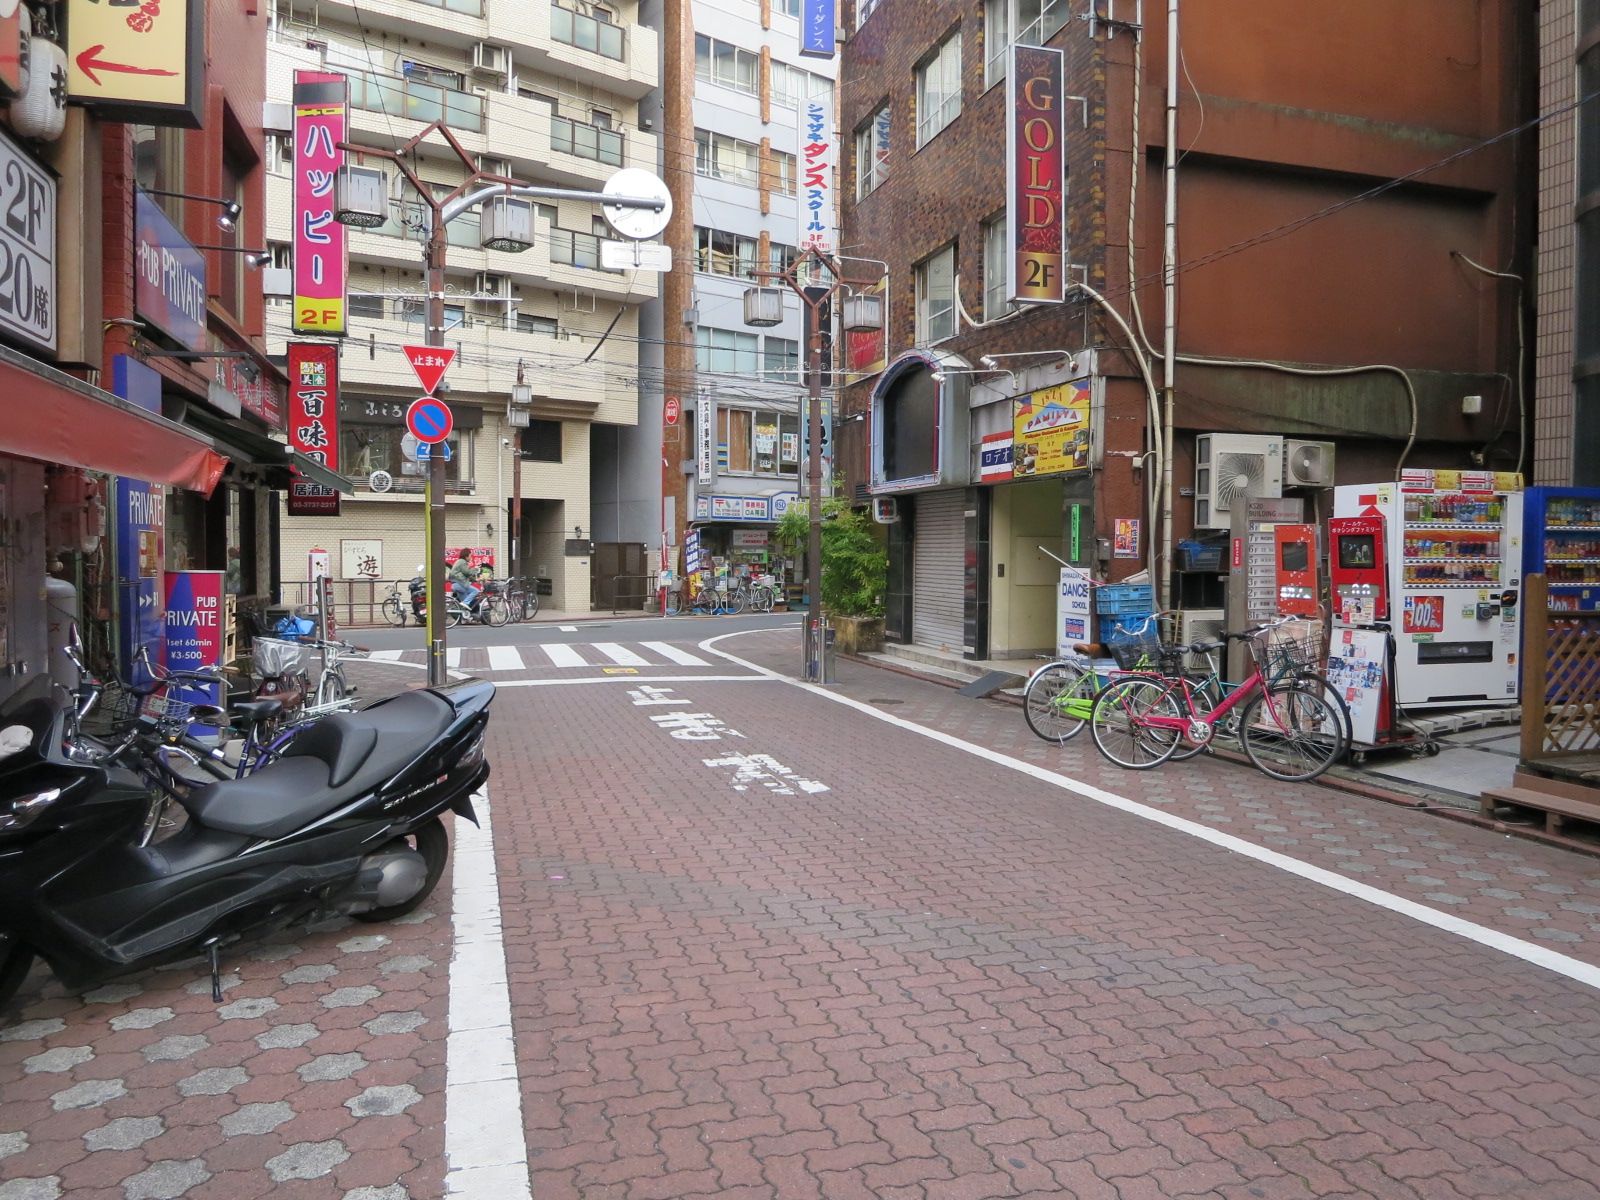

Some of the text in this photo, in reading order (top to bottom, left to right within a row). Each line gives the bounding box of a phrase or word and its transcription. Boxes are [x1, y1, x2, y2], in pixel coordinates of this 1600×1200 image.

[1024, 76, 1055, 229] GOLD
[1023, 258, 1055, 288] 2F
[142, 239, 204, 327] PUB PRIVATE
[301, 309, 338, 325] 2F
[413, 355, 446, 367] 止まれ
[294, 483, 334, 496] 居酒屋
[129, 491, 163, 526] PRIVATE
[357, 555, 380, 577] 遊
[1062, 583, 1088, 597] DANCE
[196, 596, 217, 608] PUB
[1072, 601, 1087, 609] SCHOOL
